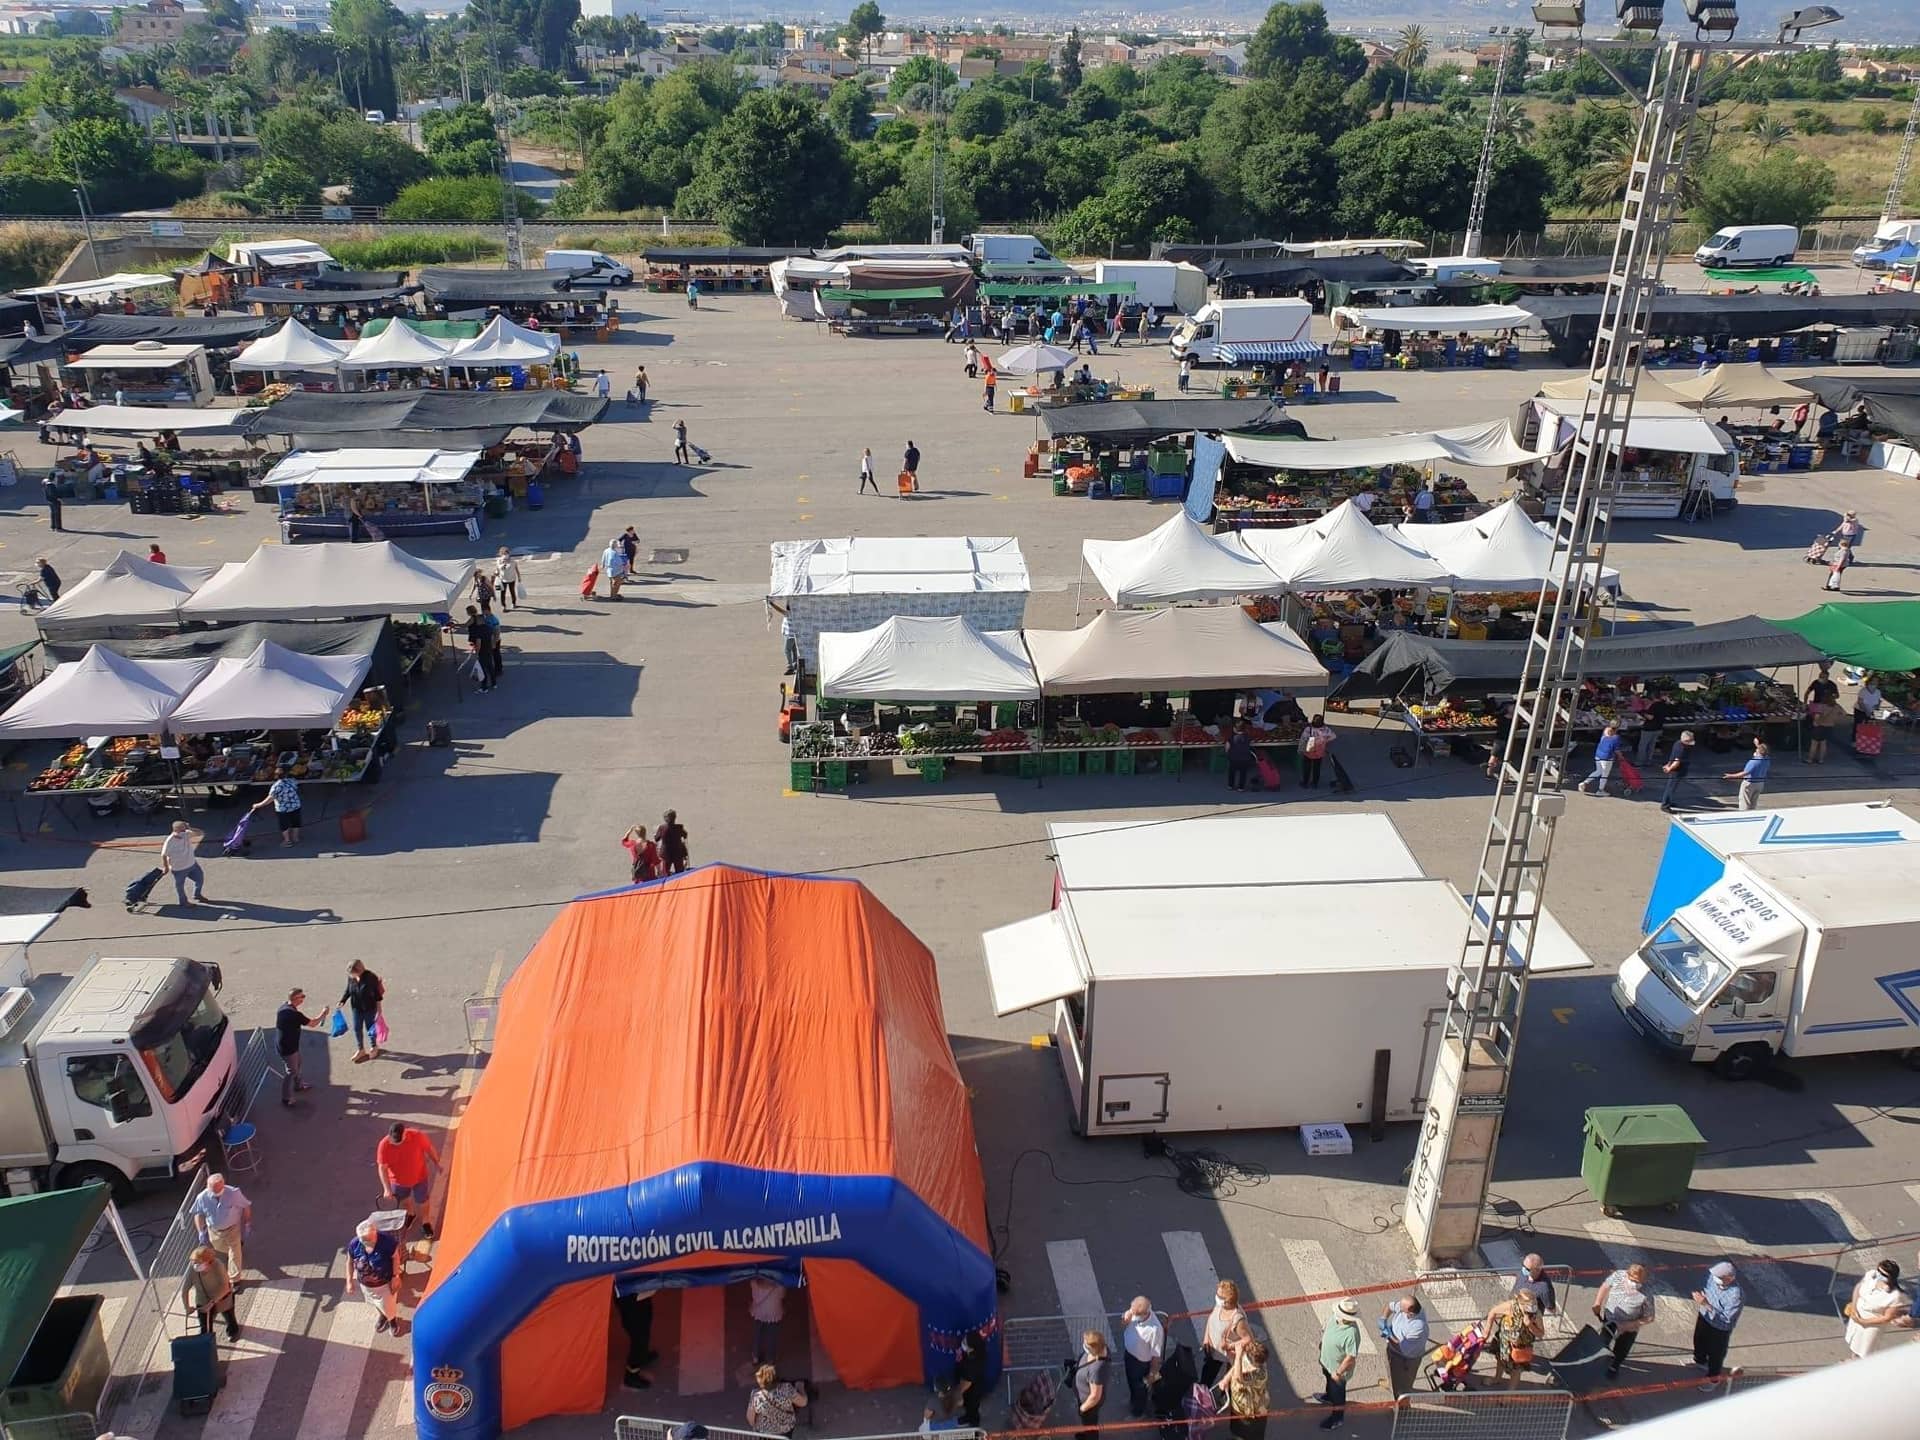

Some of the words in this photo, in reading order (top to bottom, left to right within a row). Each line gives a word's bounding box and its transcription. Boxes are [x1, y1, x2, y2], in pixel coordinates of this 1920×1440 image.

[1729, 883, 1778, 921] REMEDIOS
[1730, 908, 1745, 917] E
[567, 1229, 671, 1263] PROTECCIÓN
[675, 1231, 719, 1253] CIVIL
[723, 1213, 842, 1249] ALCANTARILLA
